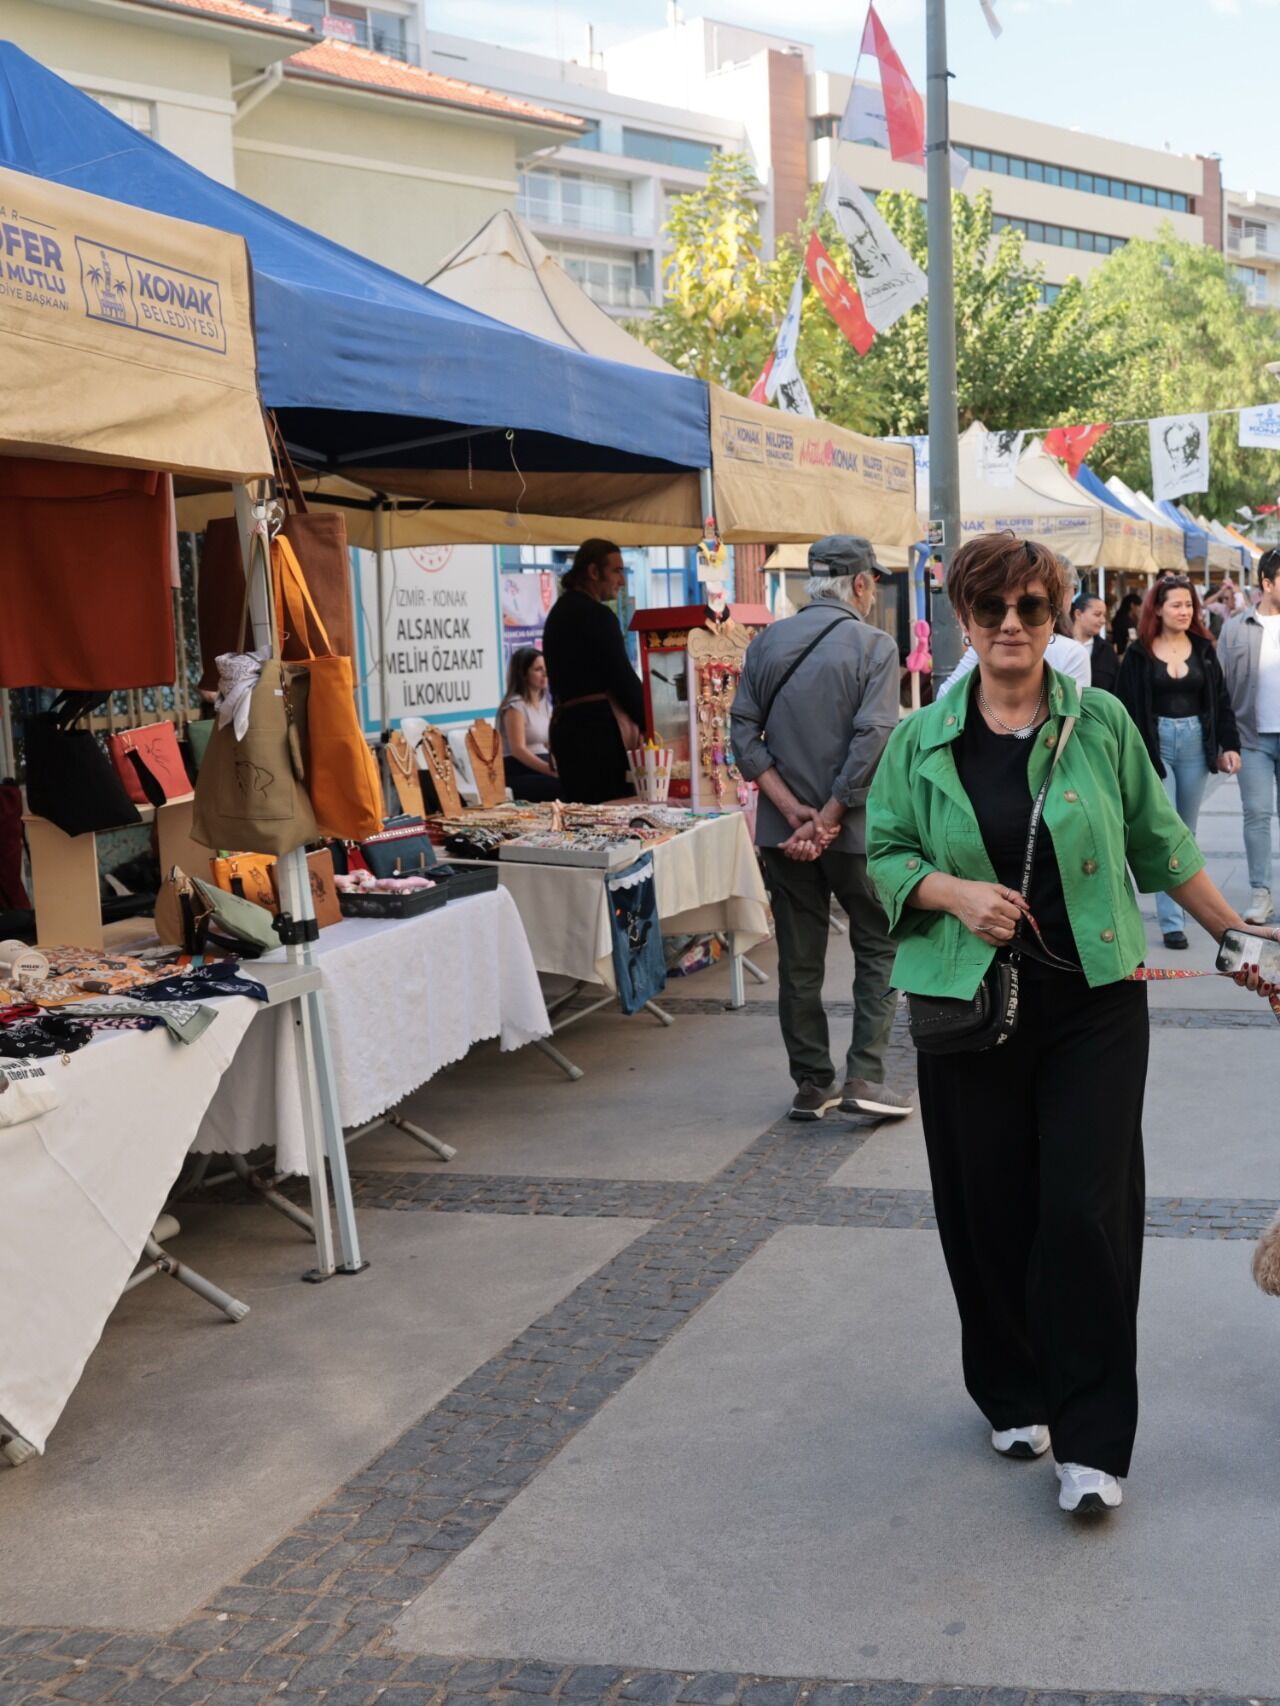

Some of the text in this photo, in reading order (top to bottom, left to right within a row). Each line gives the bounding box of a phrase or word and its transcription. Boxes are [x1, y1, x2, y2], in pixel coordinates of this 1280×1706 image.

[0, 222, 64, 272] FER
[6, 261, 66, 295] MUTLU
[25, 290, 69, 312] BAŞKANI
[137, 270, 214, 318] KONAK
[141, 302, 219, 339] BELEDİYESİ
[395, 585, 425, 607] İZMİR
[433, 588, 469, 607] KONAK
[397, 617, 471, 640] ALSANCAK
[431, 645, 484, 672] ÖZAKAT
[403, 680, 471, 707] İLKOKULU
